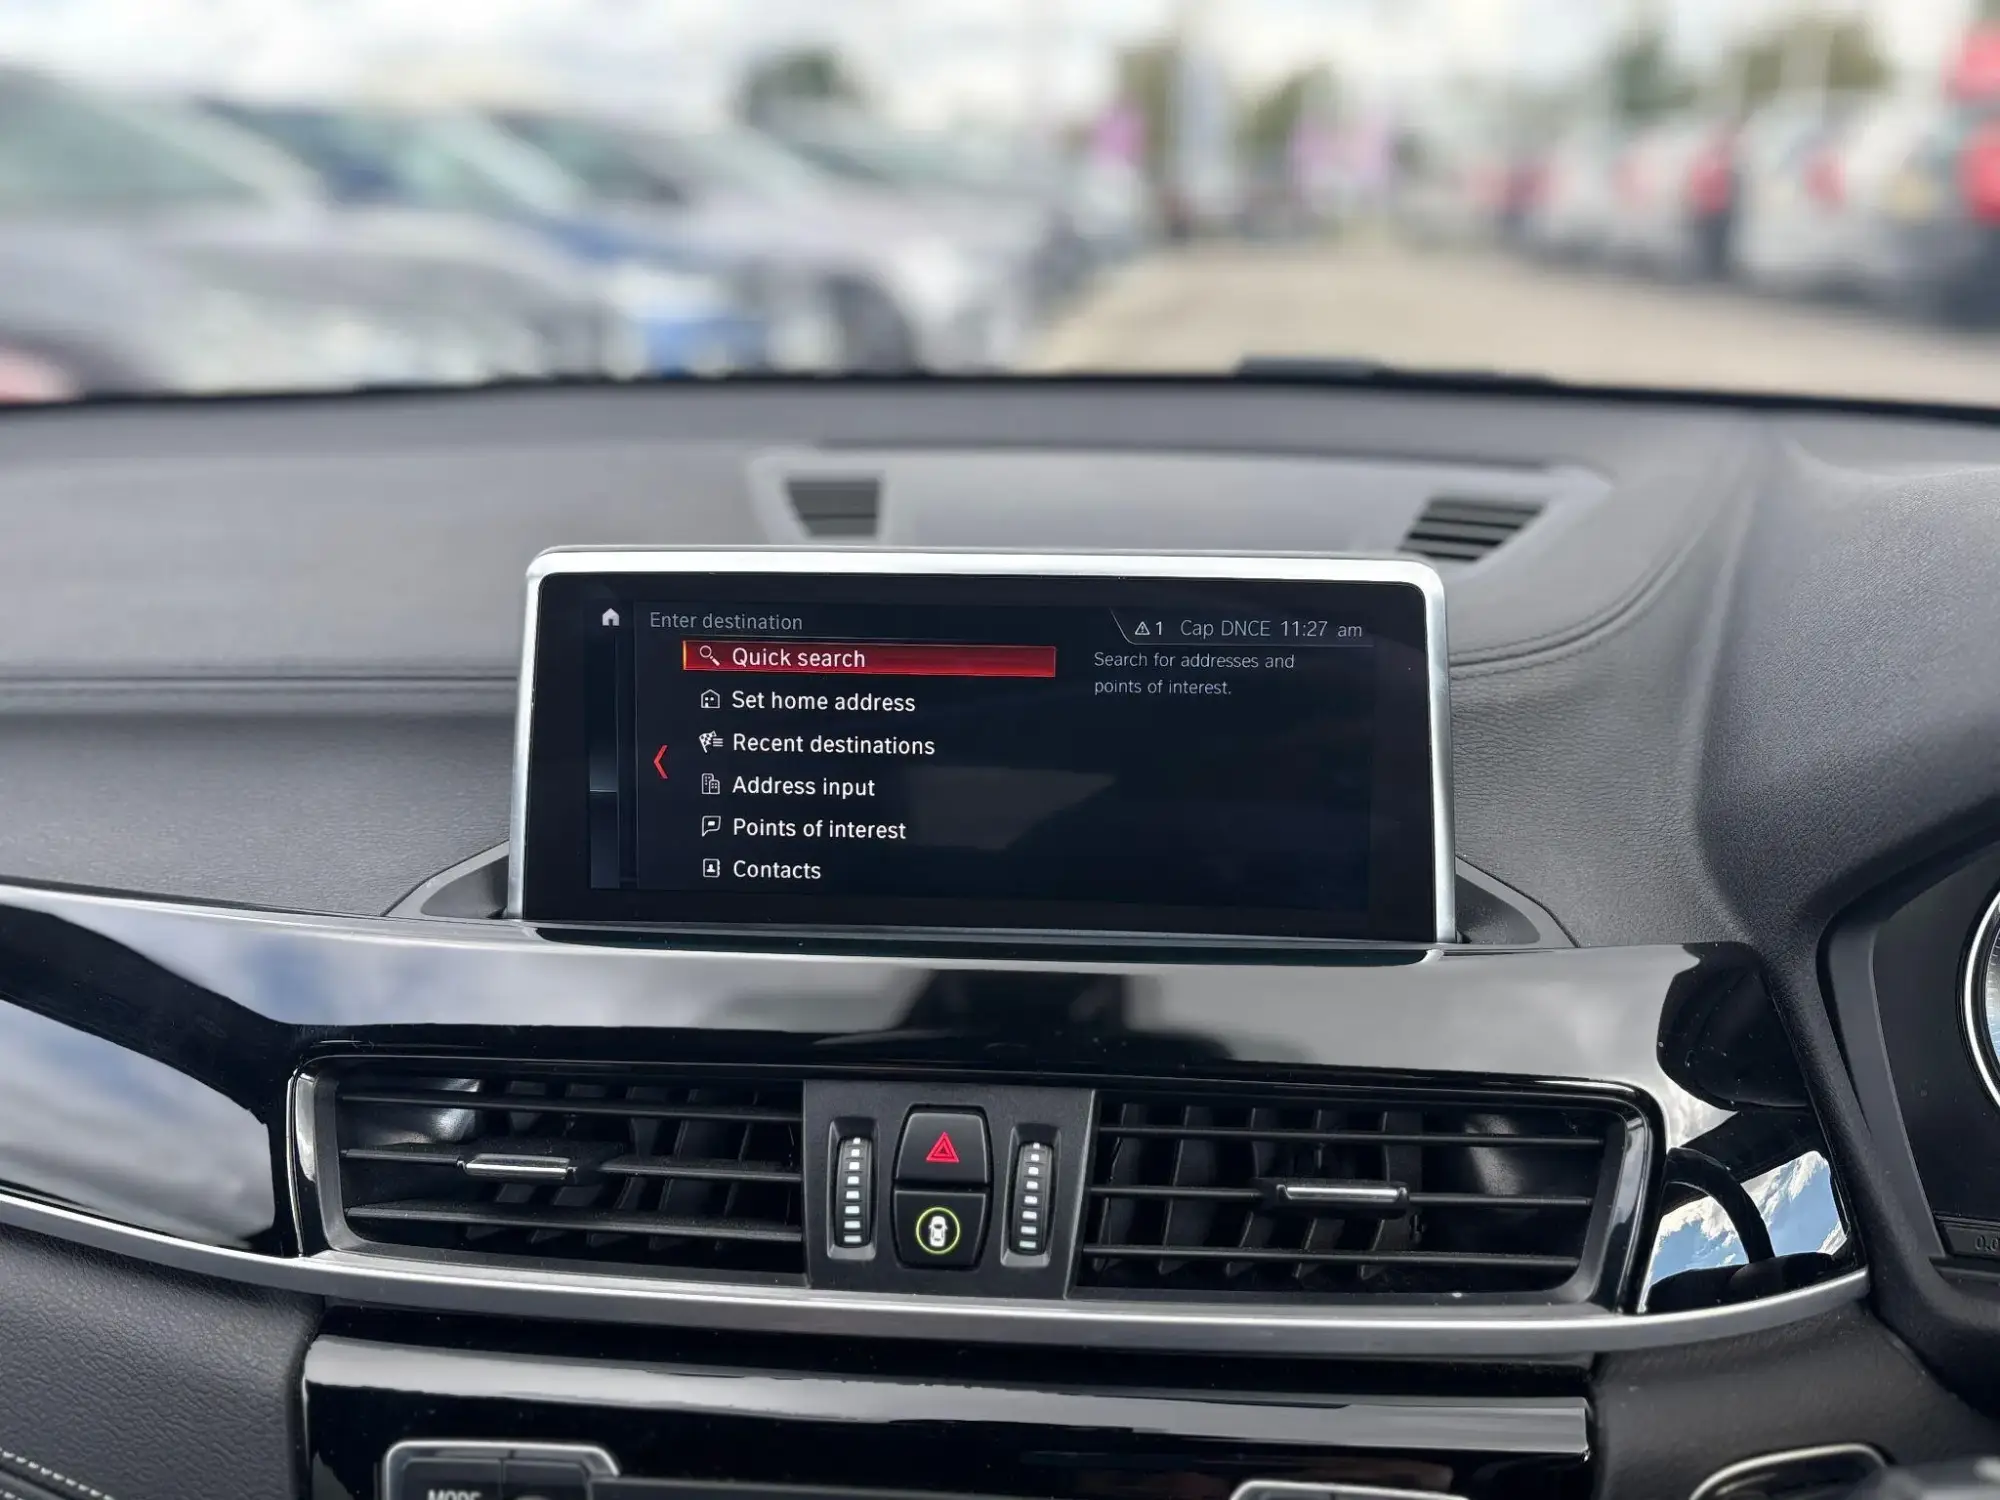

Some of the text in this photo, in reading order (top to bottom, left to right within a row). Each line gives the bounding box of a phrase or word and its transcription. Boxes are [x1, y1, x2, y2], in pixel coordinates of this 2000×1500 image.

[650, 611, 803, 630] Enter destination
[1155, 621, 1162, 636] 1
[1180, 619, 1271, 640] Cap DNCE
[1280, 620, 1362, 638] 11:27 am
[732, 647, 865, 668] Quick search
[1094, 651, 1295, 669] Search for addresses and
[1094, 679, 1231, 696] points of interest.
[732, 690, 916, 712] Set home address
[733, 732, 935, 755] Recent destinations
[732, 775, 876, 800] Address input
[733, 817, 907, 840] Points of interest
[733, 859, 822, 880] Contacts
